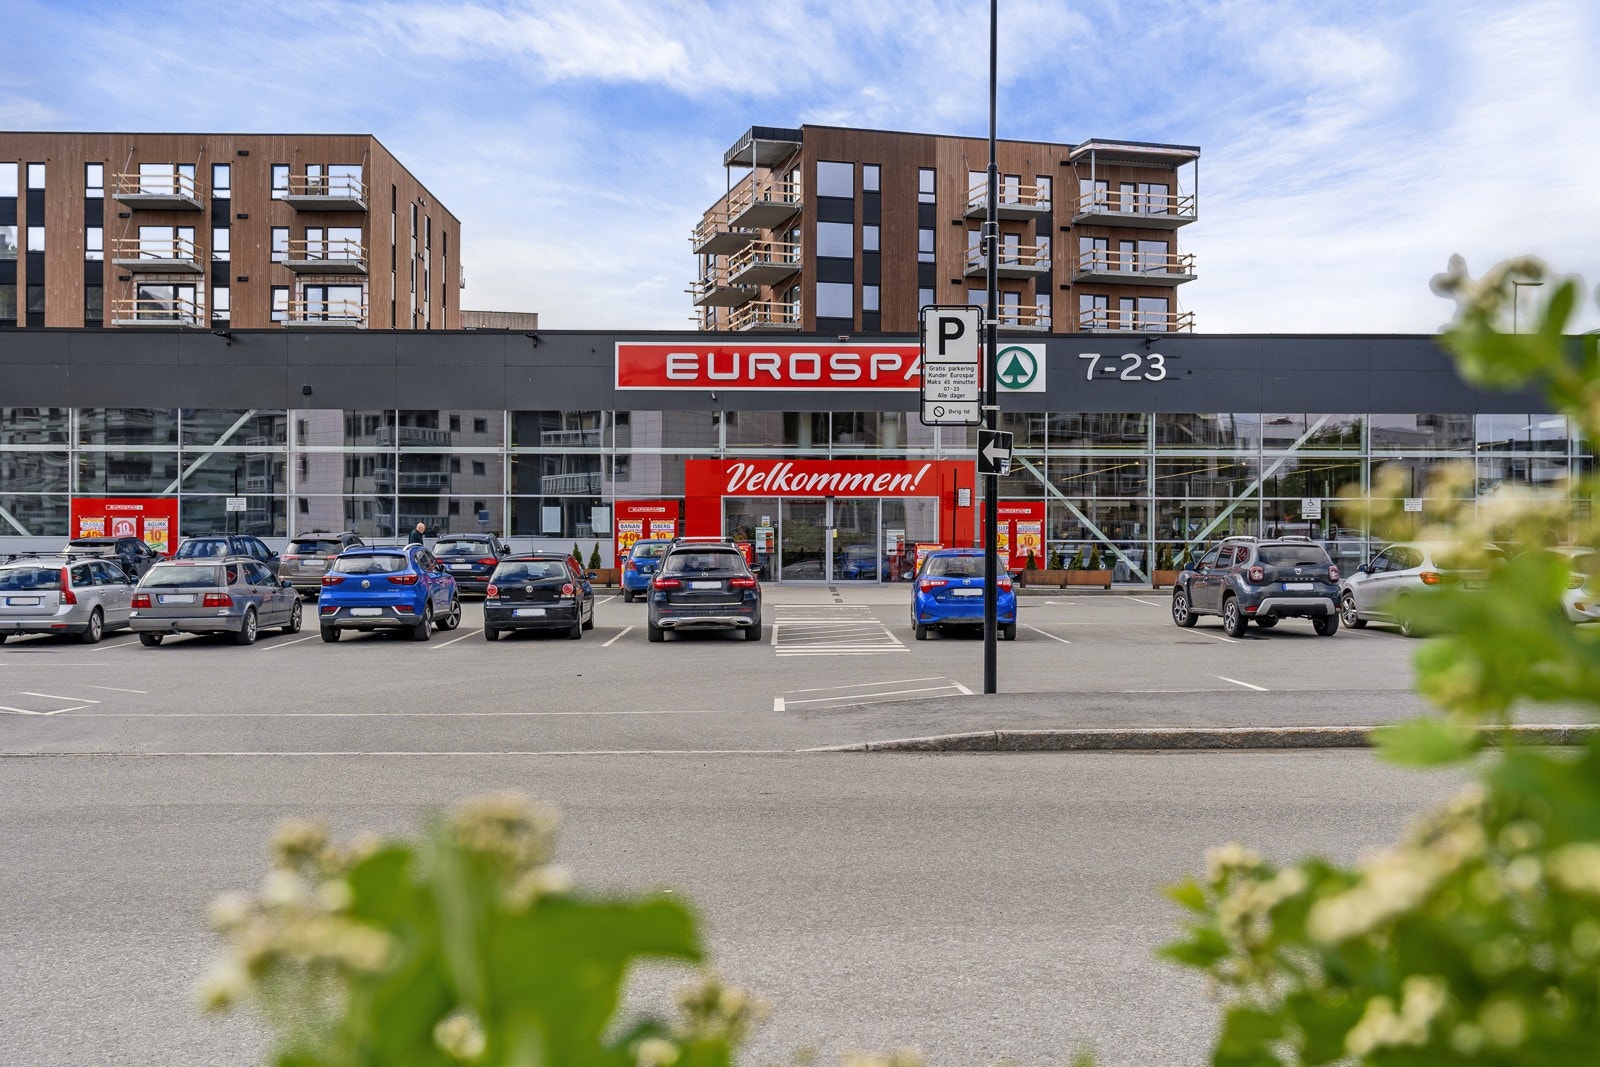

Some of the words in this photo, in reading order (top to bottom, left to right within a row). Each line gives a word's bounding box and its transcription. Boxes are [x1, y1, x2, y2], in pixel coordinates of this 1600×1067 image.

[939, 317, 965, 355] P
[948, 365, 975, 373] parkering
[1078, 353, 1167, 381] 7-23
[726, 462, 932, 493] Velkommen!
[149, 528, 162, 542] 10
[1023, 536, 1034, 546] 10
